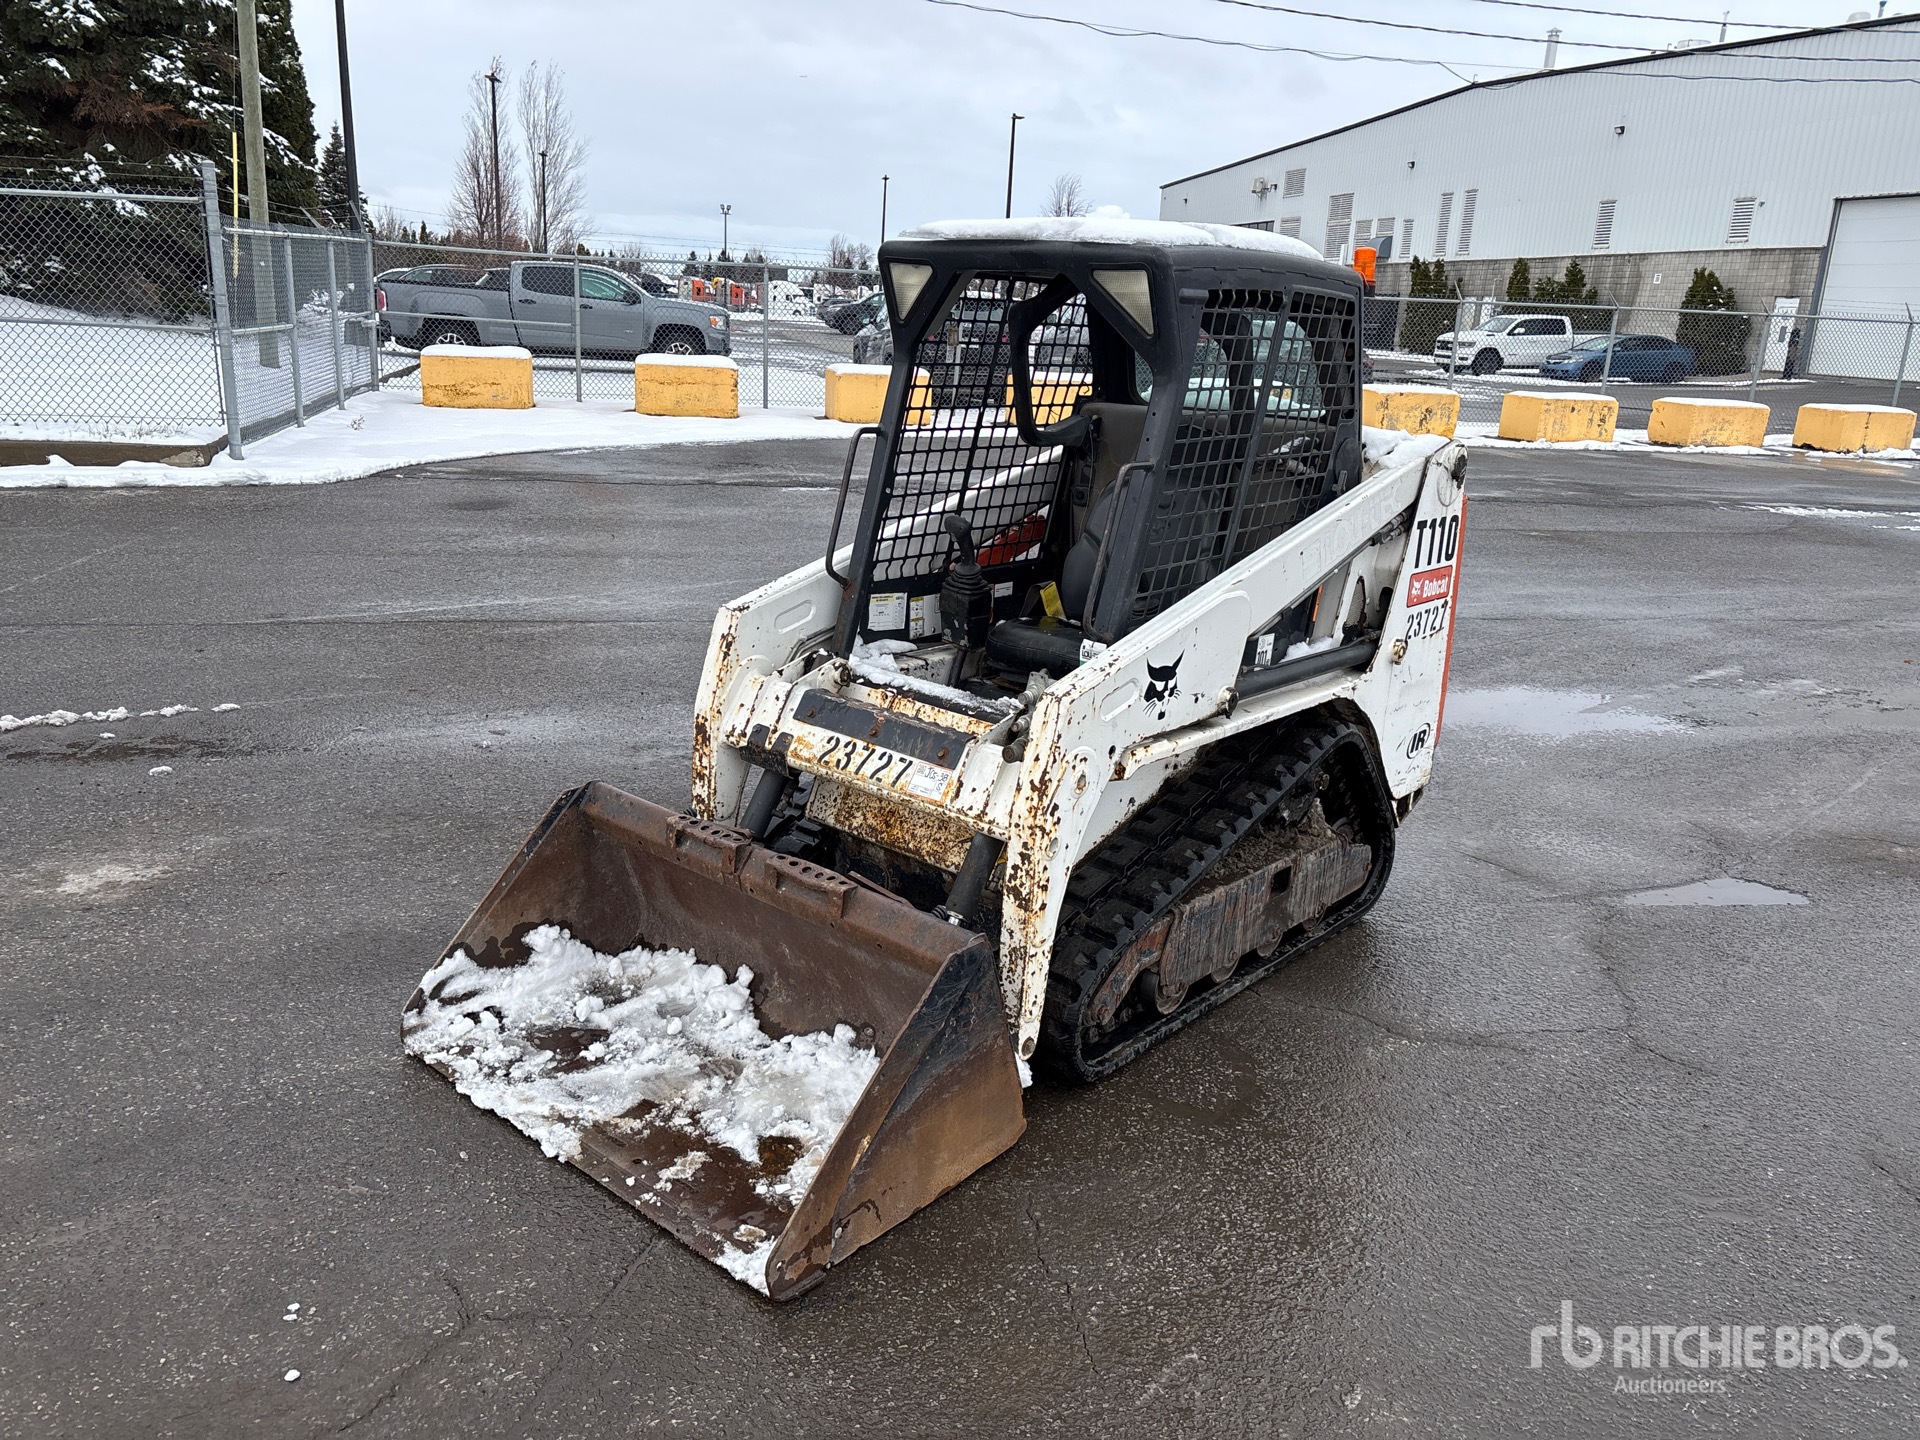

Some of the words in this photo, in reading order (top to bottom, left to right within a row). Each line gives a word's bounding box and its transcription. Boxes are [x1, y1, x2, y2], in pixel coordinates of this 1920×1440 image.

[1414, 514, 1460, 569] T110
[1422, 576, 1448, 598] Bobcat
[1405, 599, 1449, 640] 23727
[817, 735, 913, 788] 23727
[1409, 728, 1427, 755] IR
